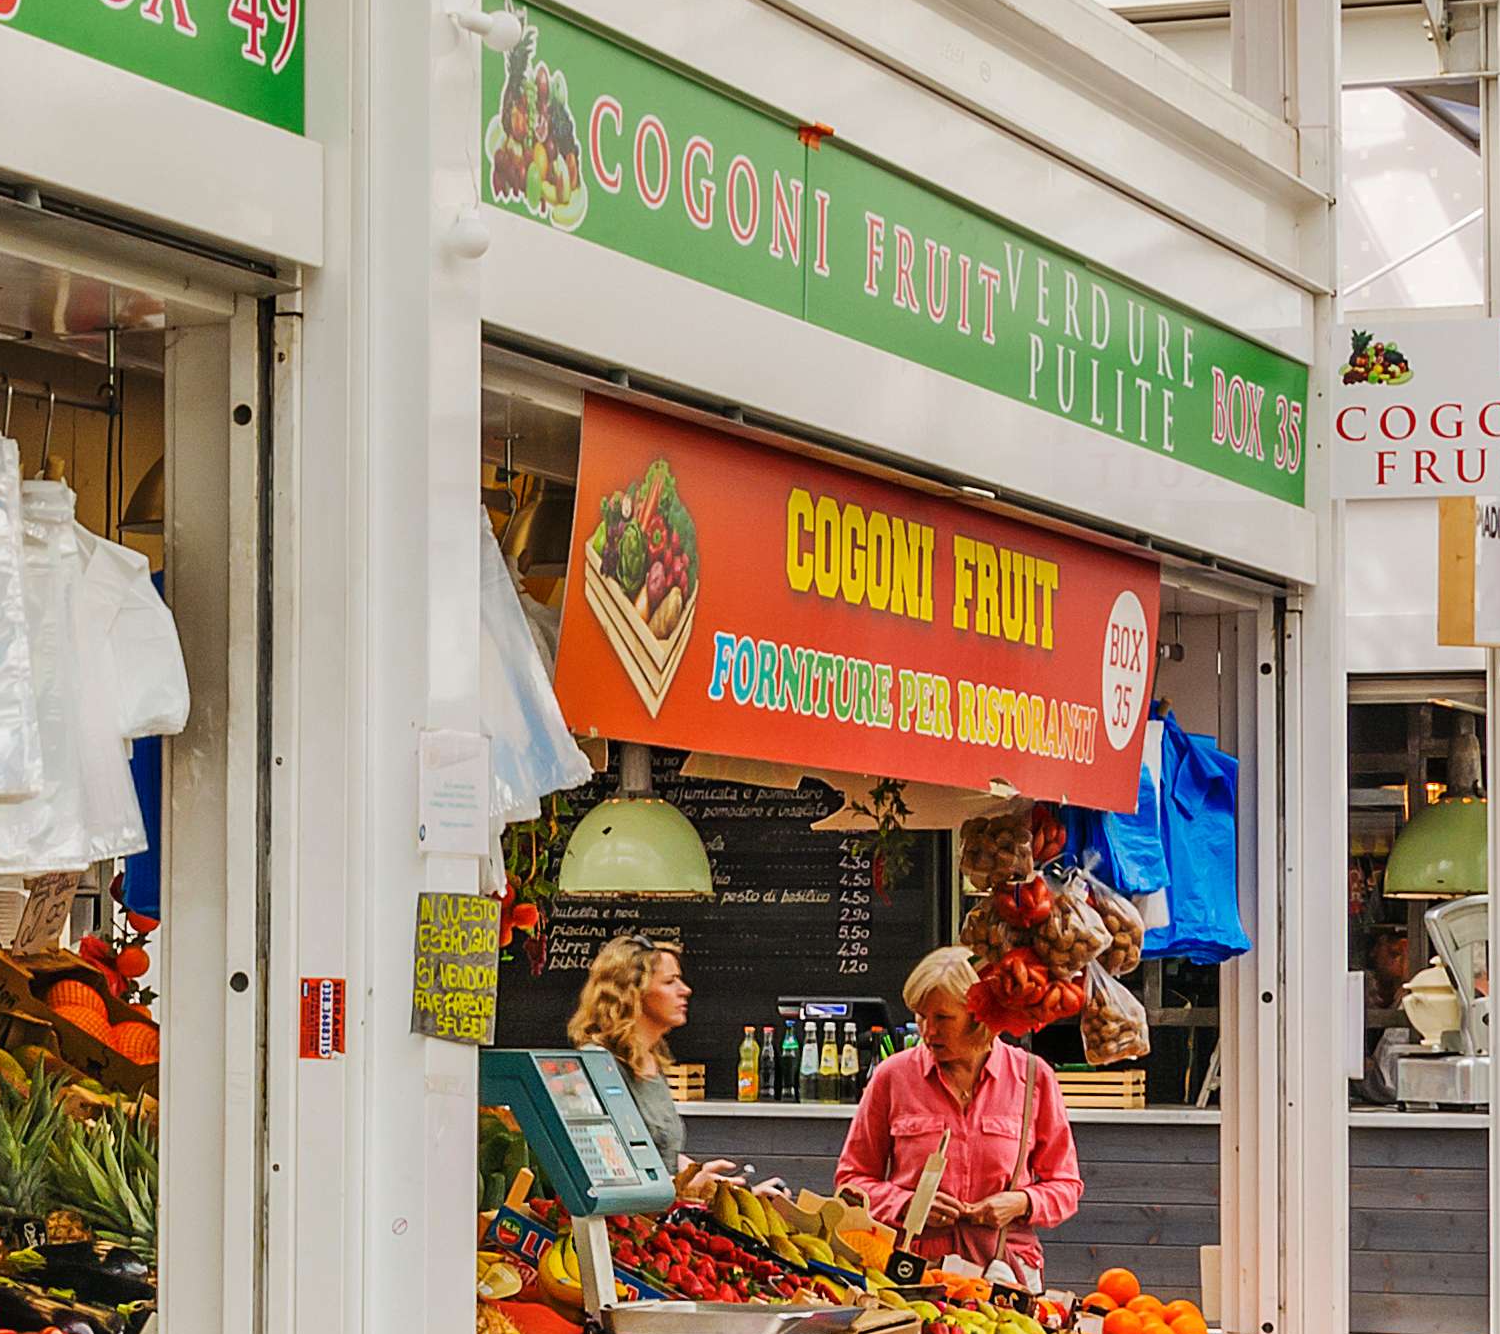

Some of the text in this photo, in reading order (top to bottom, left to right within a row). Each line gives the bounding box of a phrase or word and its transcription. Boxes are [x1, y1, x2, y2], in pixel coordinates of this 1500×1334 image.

[588, 93, 1001, 347] COGONI FRUIT
[1028, 332, 1175, 454] PULITE
[1211, 365, 1303, 476] BOX 35
[786, 487, 1060, 650] COGONI FRUIT
[708, 630, 1099, 765] FORNITURE PER RISTORANTI
[1109, 622, 1144, 674] BOX
[1113, 682, 1134, 729] 35
[421, 894, 498, 926] IN QUESTO
[550, 940, 591, 955] birra
